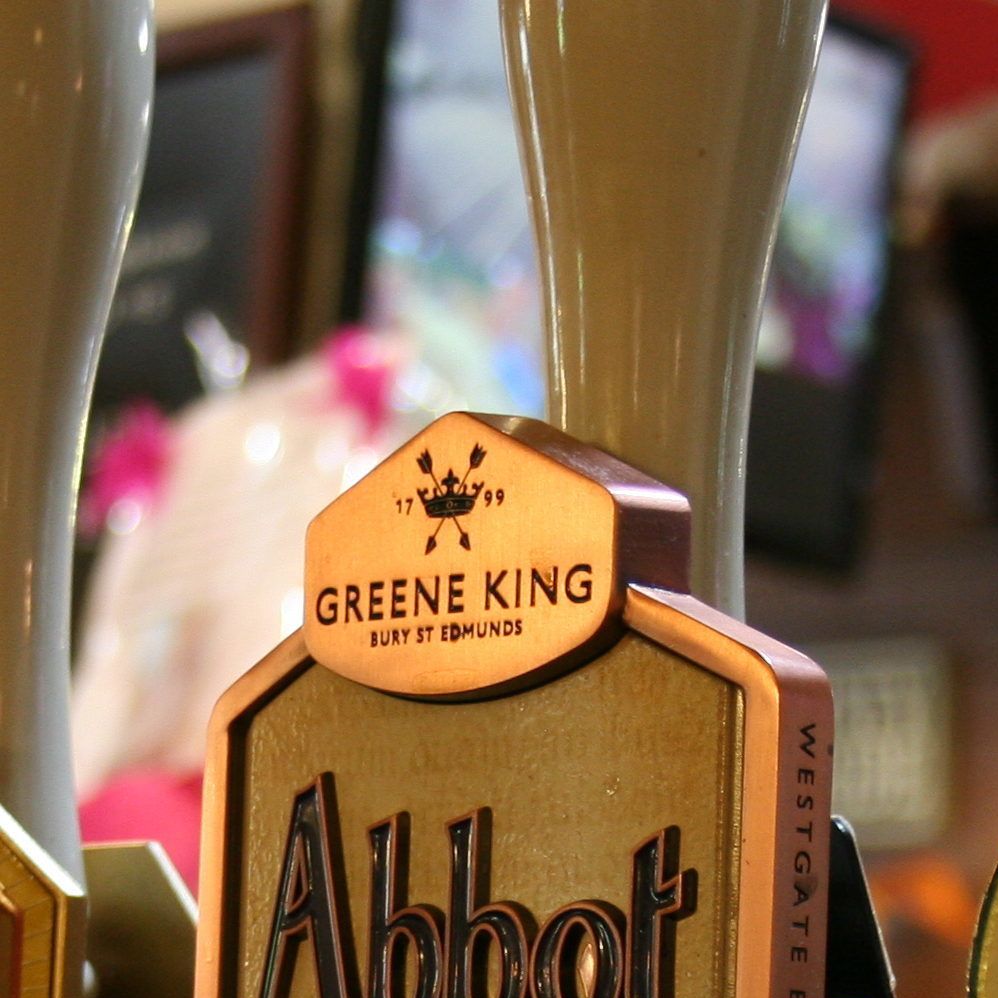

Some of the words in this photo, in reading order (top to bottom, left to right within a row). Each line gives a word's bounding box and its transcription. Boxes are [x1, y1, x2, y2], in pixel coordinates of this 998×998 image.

[316, 573, 466, 626] GREENE
[484, 563, 594, 612] KING
[370, 630, 410, 648] BURY
[416, 626, 435, 643] ST
[441, 619, 523, 642] EDMUNDS
[789, 723, 816, 964] WESTGATE
